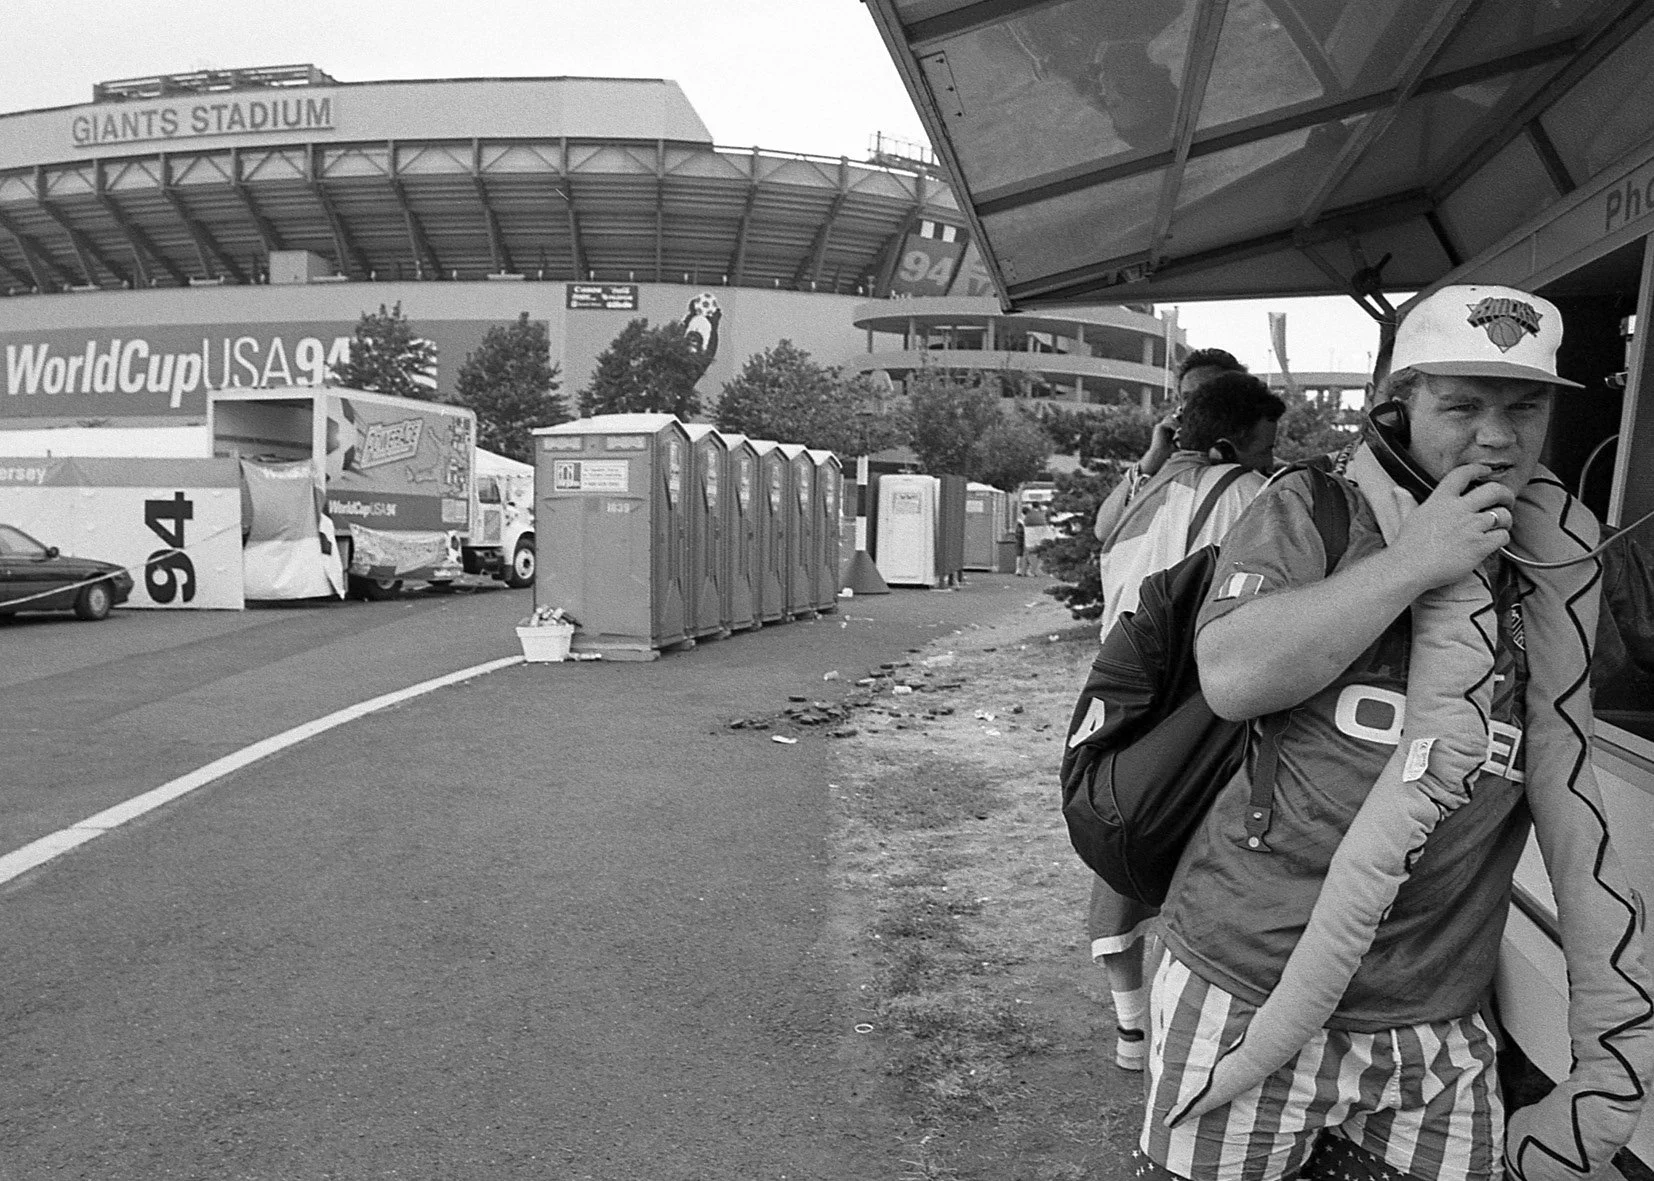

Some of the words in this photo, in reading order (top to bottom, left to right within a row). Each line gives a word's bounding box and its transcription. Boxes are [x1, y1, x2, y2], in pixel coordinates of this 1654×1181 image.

[71, 107, 179, 143] GIANTS
[190, 97, 331, 133] STADIUM
[900, 250, 954, 287] 94
[144, 491, 196, 604] 94
[1334, 684, 1526, 784] OEL
